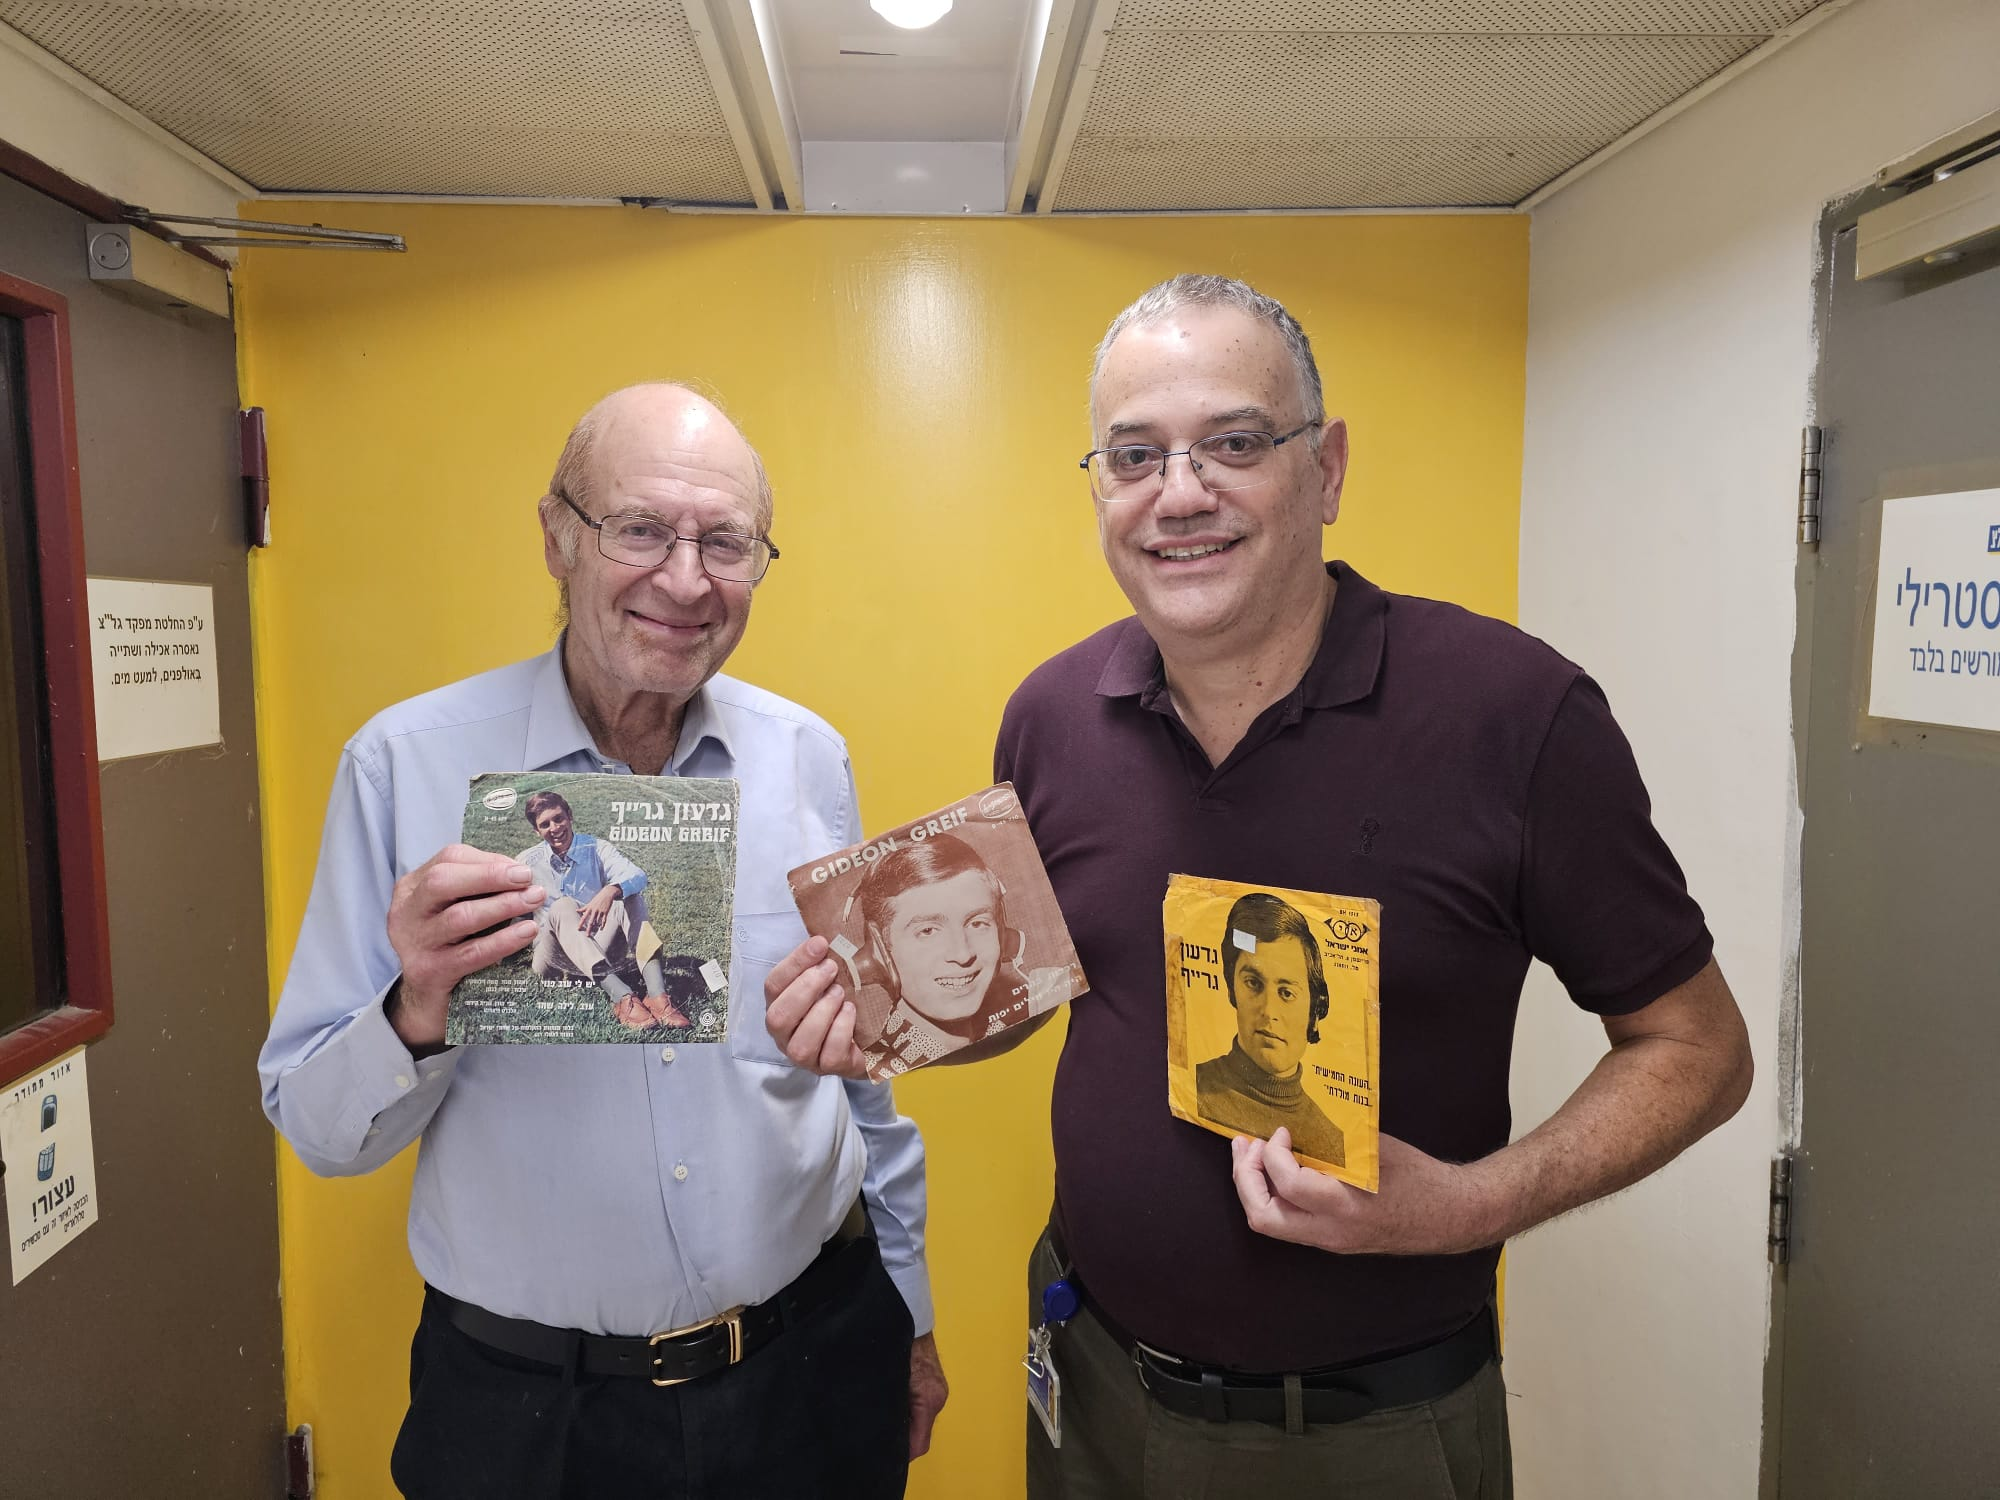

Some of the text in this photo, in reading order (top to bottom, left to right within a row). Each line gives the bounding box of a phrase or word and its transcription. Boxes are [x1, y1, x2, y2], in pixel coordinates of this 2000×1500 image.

[125, 618, 152, 633] מפקד
[155, 615, 186, 630] החלטת
[109, 640, 200, 657] נאסרה אכילה ושתייה
[1909, 640, 1945, 673] בלבד
[111, 671, 130, 685] מים.
[133, 666, 158, 684] למעט
[672, 802, 732, 825] גדעון
[608, 825, 731, 843] GIDEON GREIF
[811, 806, 968, 884] GIDEON GREIF
[1180, 942, 1218, 965] גדעון
[1325, 938, 1350, 951] ישראל
[575, 979, 583, 988] לי
[585, 980, 596, 988] יש
[1181, 967, 1219, 991] גרייף
[988, 1007, 1010, 1023] יפות
[14, 1062, 71, 1103] אזור ממודר
[32, 1175, 75, 1223] עצור!
